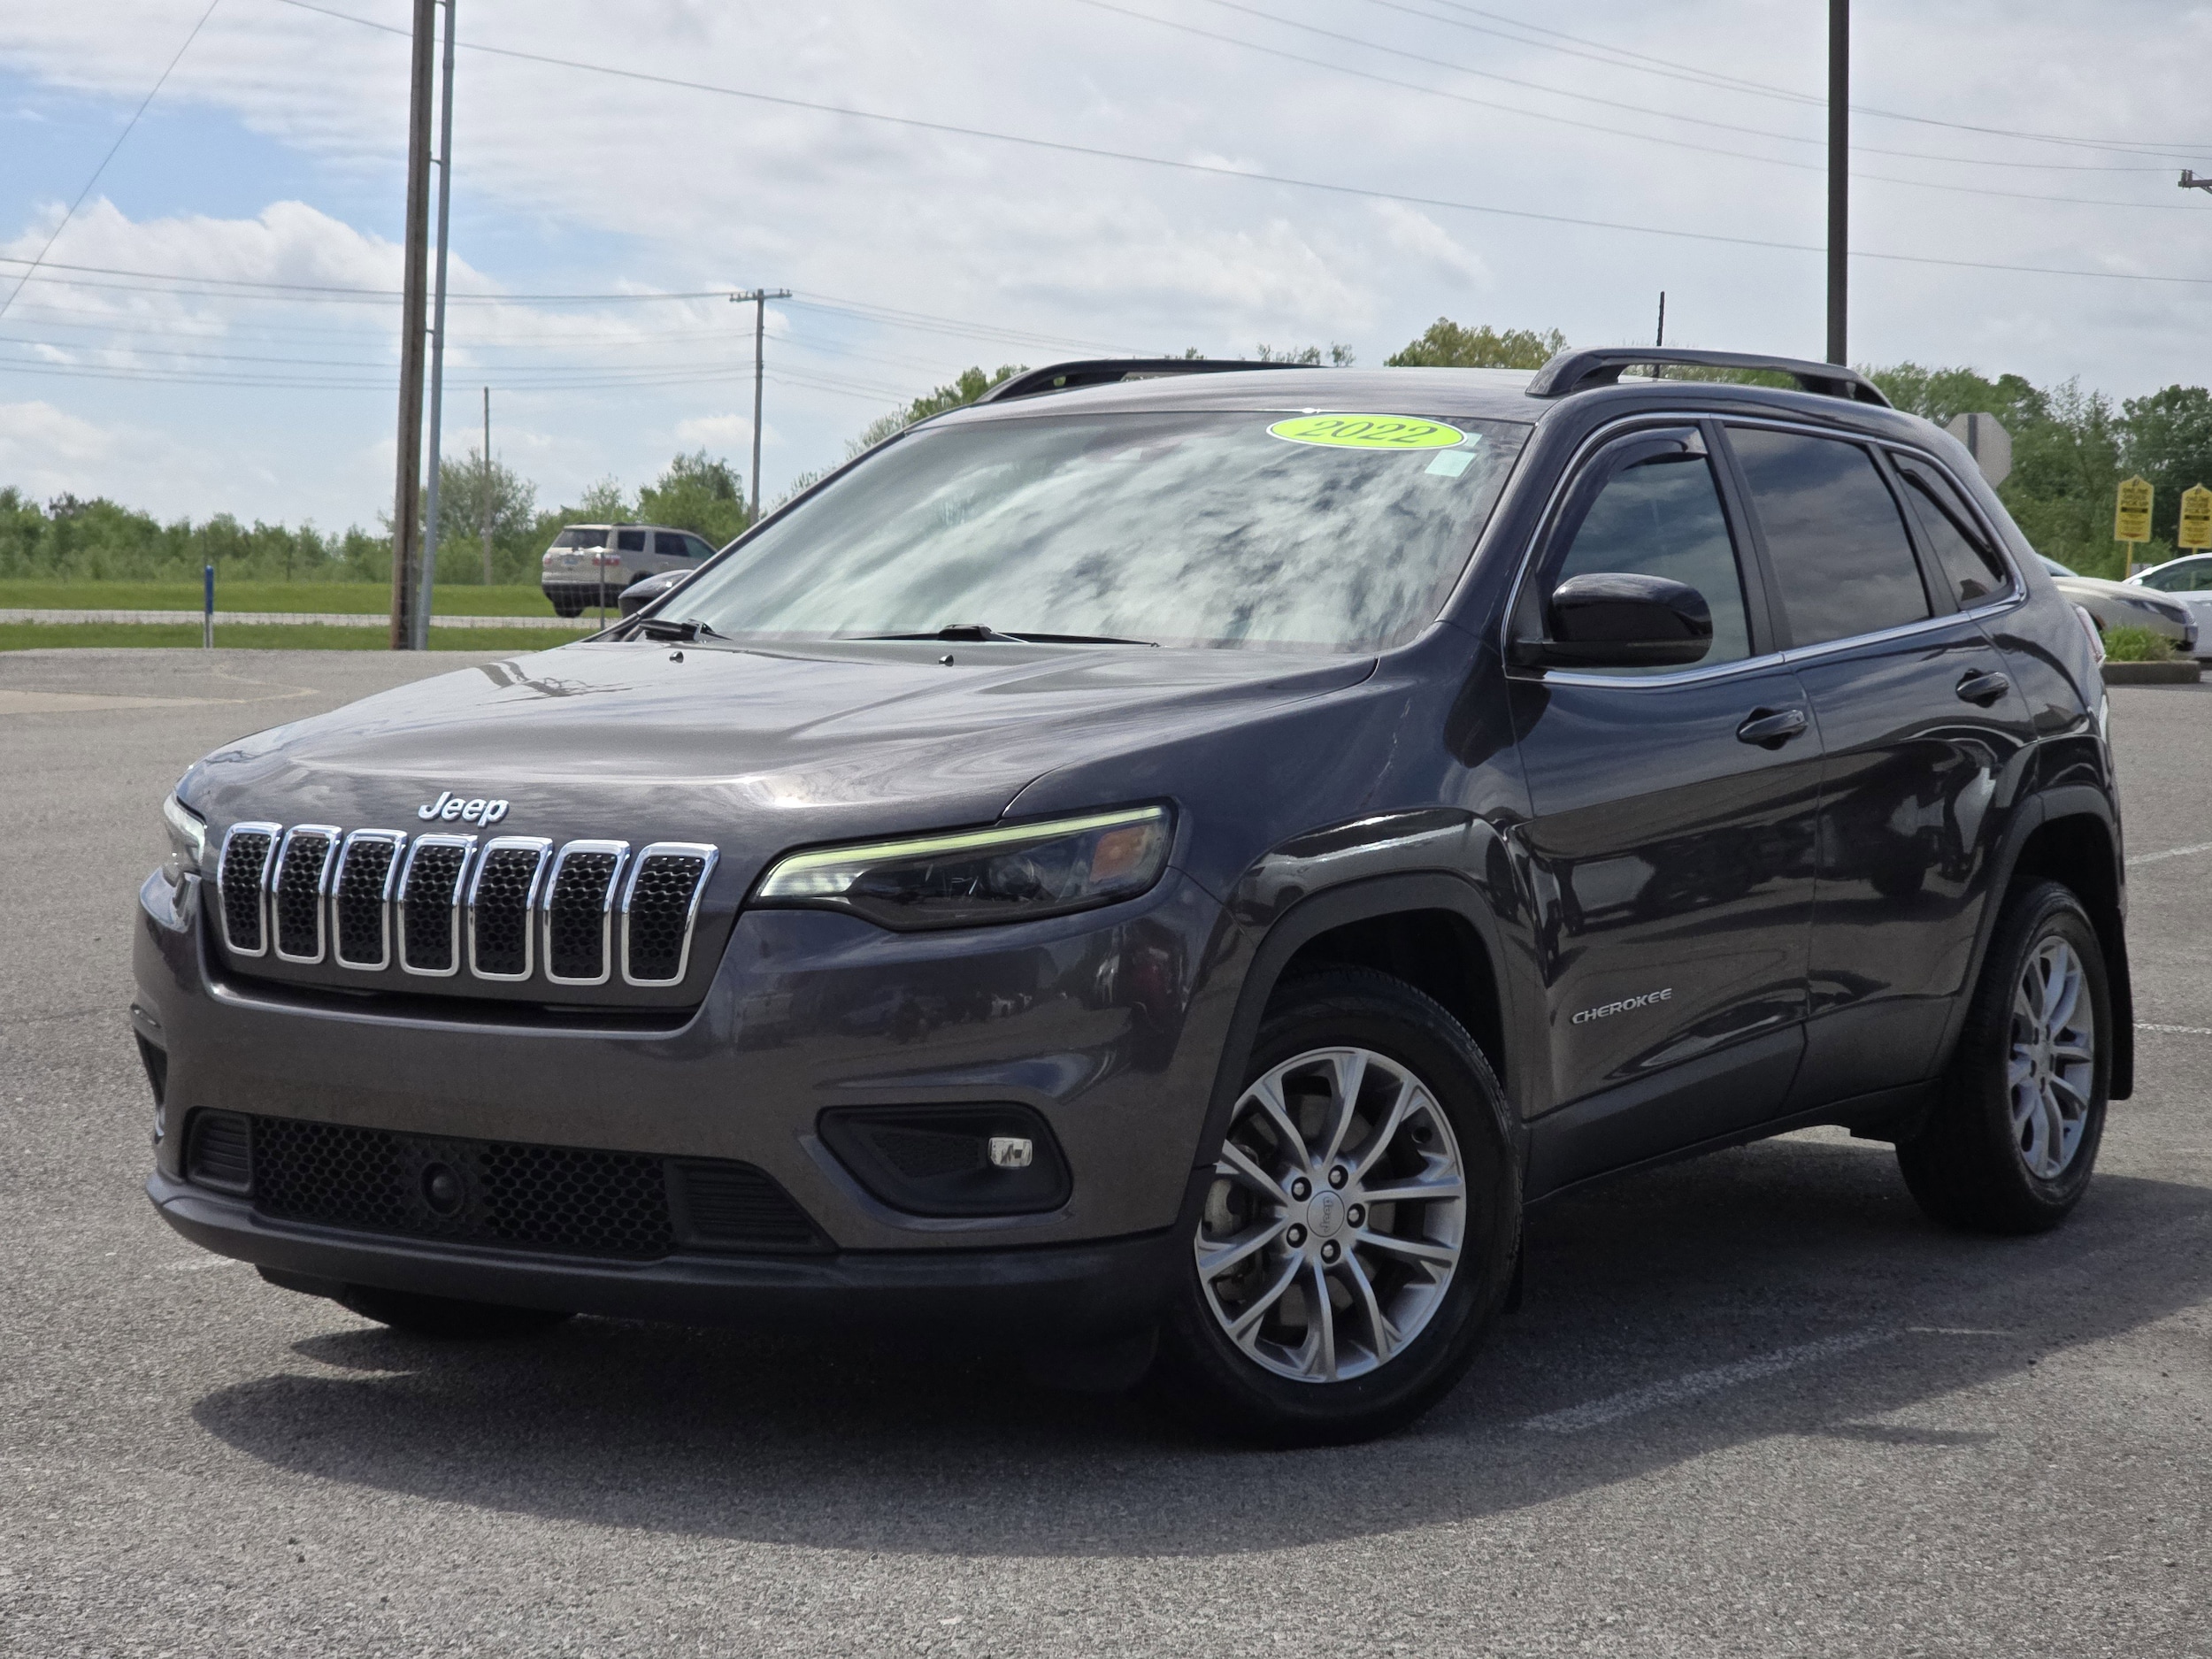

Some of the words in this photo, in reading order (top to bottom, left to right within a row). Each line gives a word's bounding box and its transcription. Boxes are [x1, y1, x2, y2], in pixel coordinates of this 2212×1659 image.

[1294, 419, 1439, 443] 2022
[418, 791, 509, 828] Jeep
[1571, 987, 1672, 1025] CHEROKEE
[1319, 1196, 1333, 1233] Jeep
